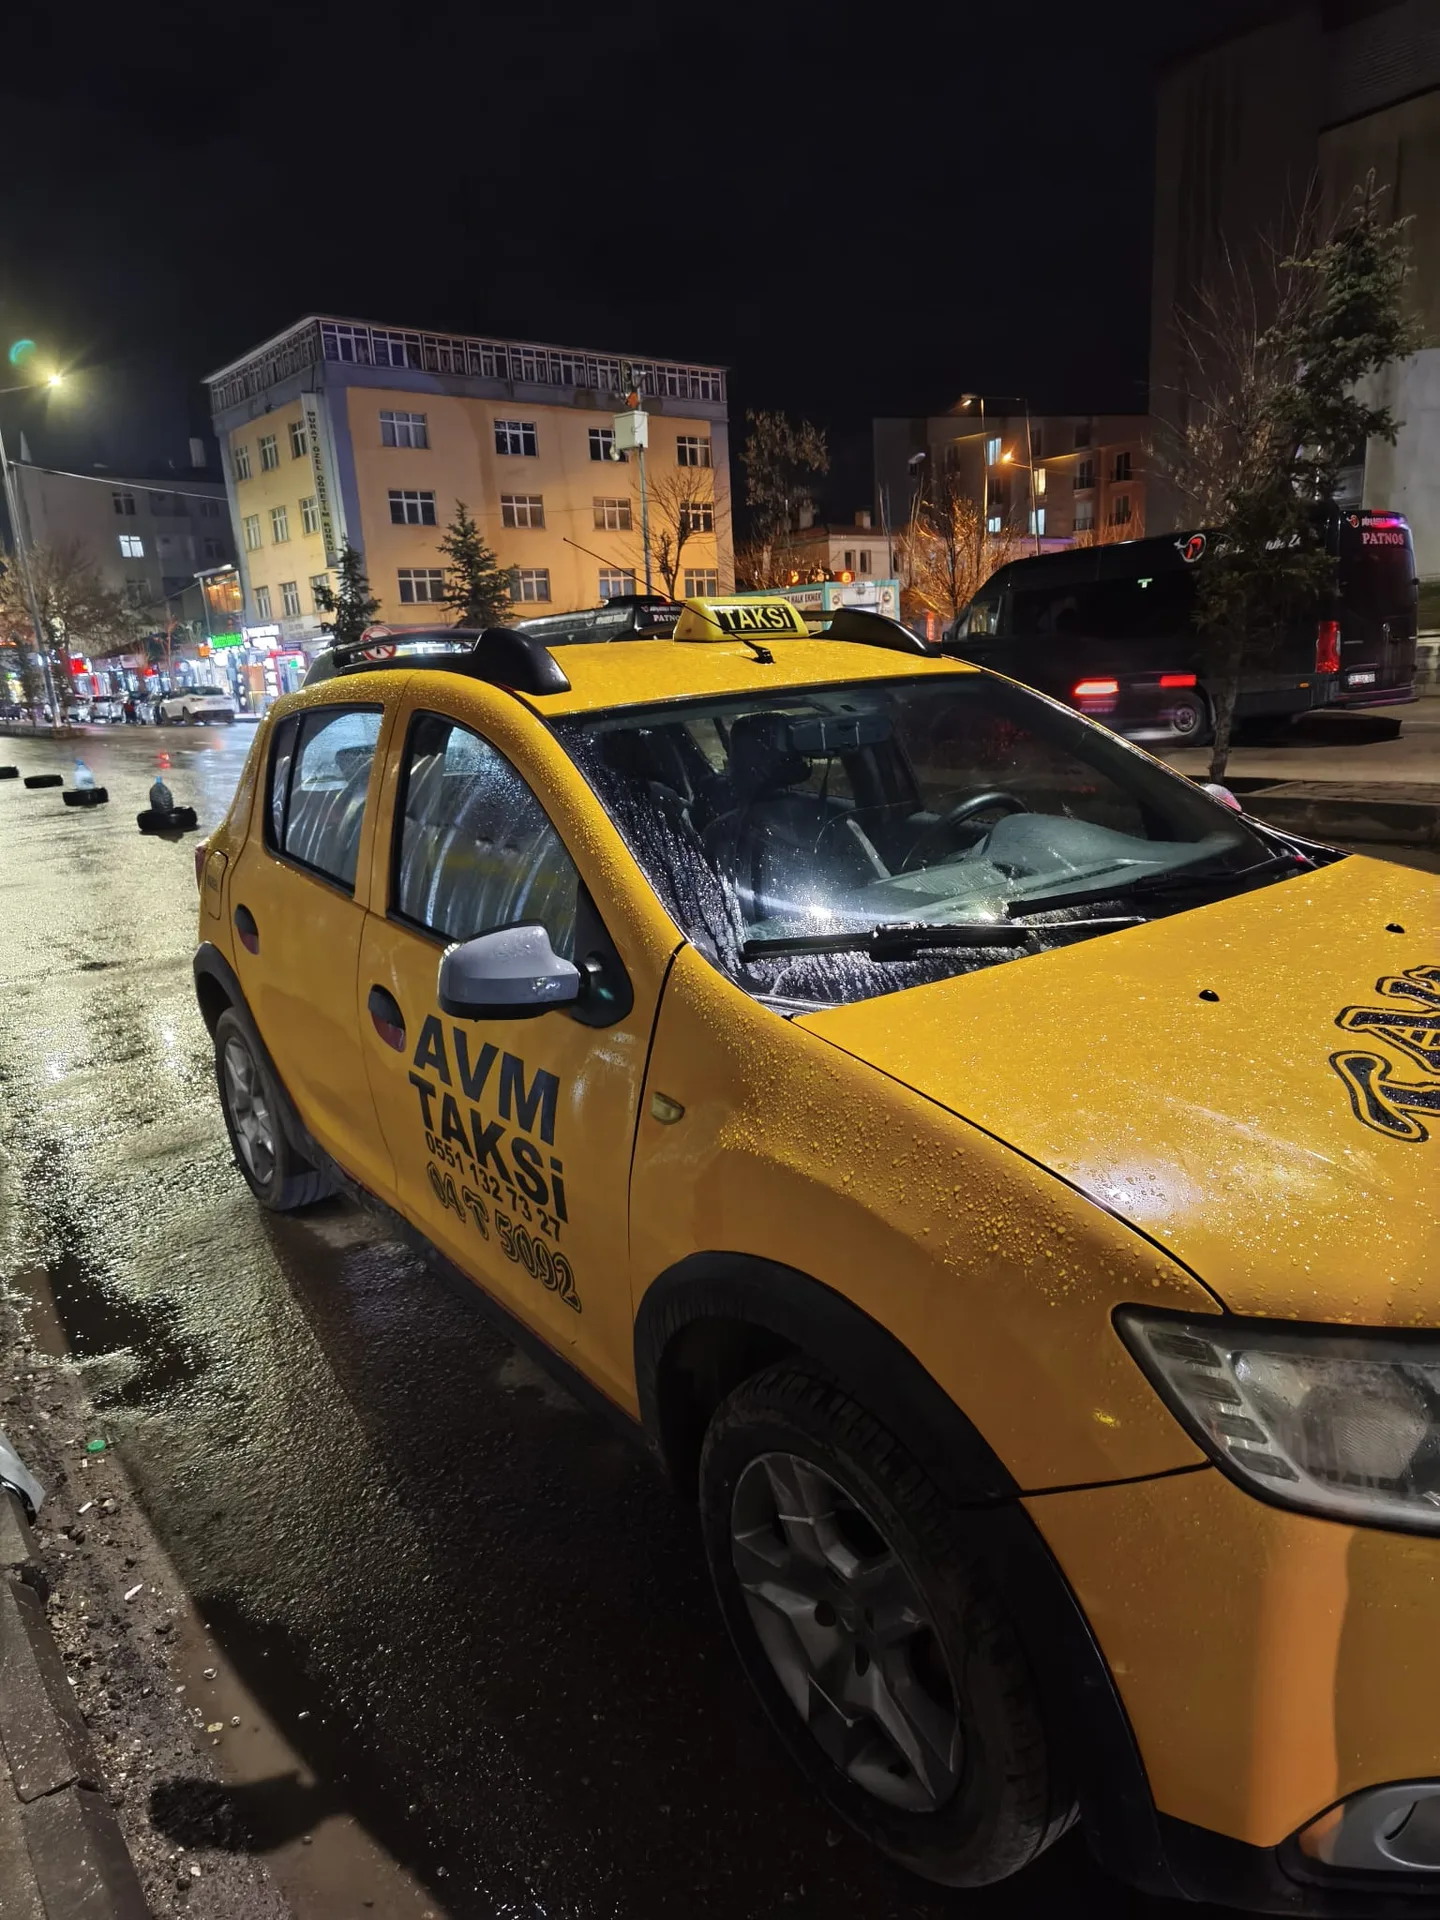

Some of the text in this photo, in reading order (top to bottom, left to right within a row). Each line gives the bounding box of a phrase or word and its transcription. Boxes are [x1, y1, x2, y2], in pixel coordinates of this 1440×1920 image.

[1362, 532, 1404, 545] PATNOS
[413, 1014, 560, 1147] AVM
[425, 1130, 561, 1242] 0551 132 73 27
[461, 1184, 489, 1242] T
[494, 1208, 582, 1313] 5092
